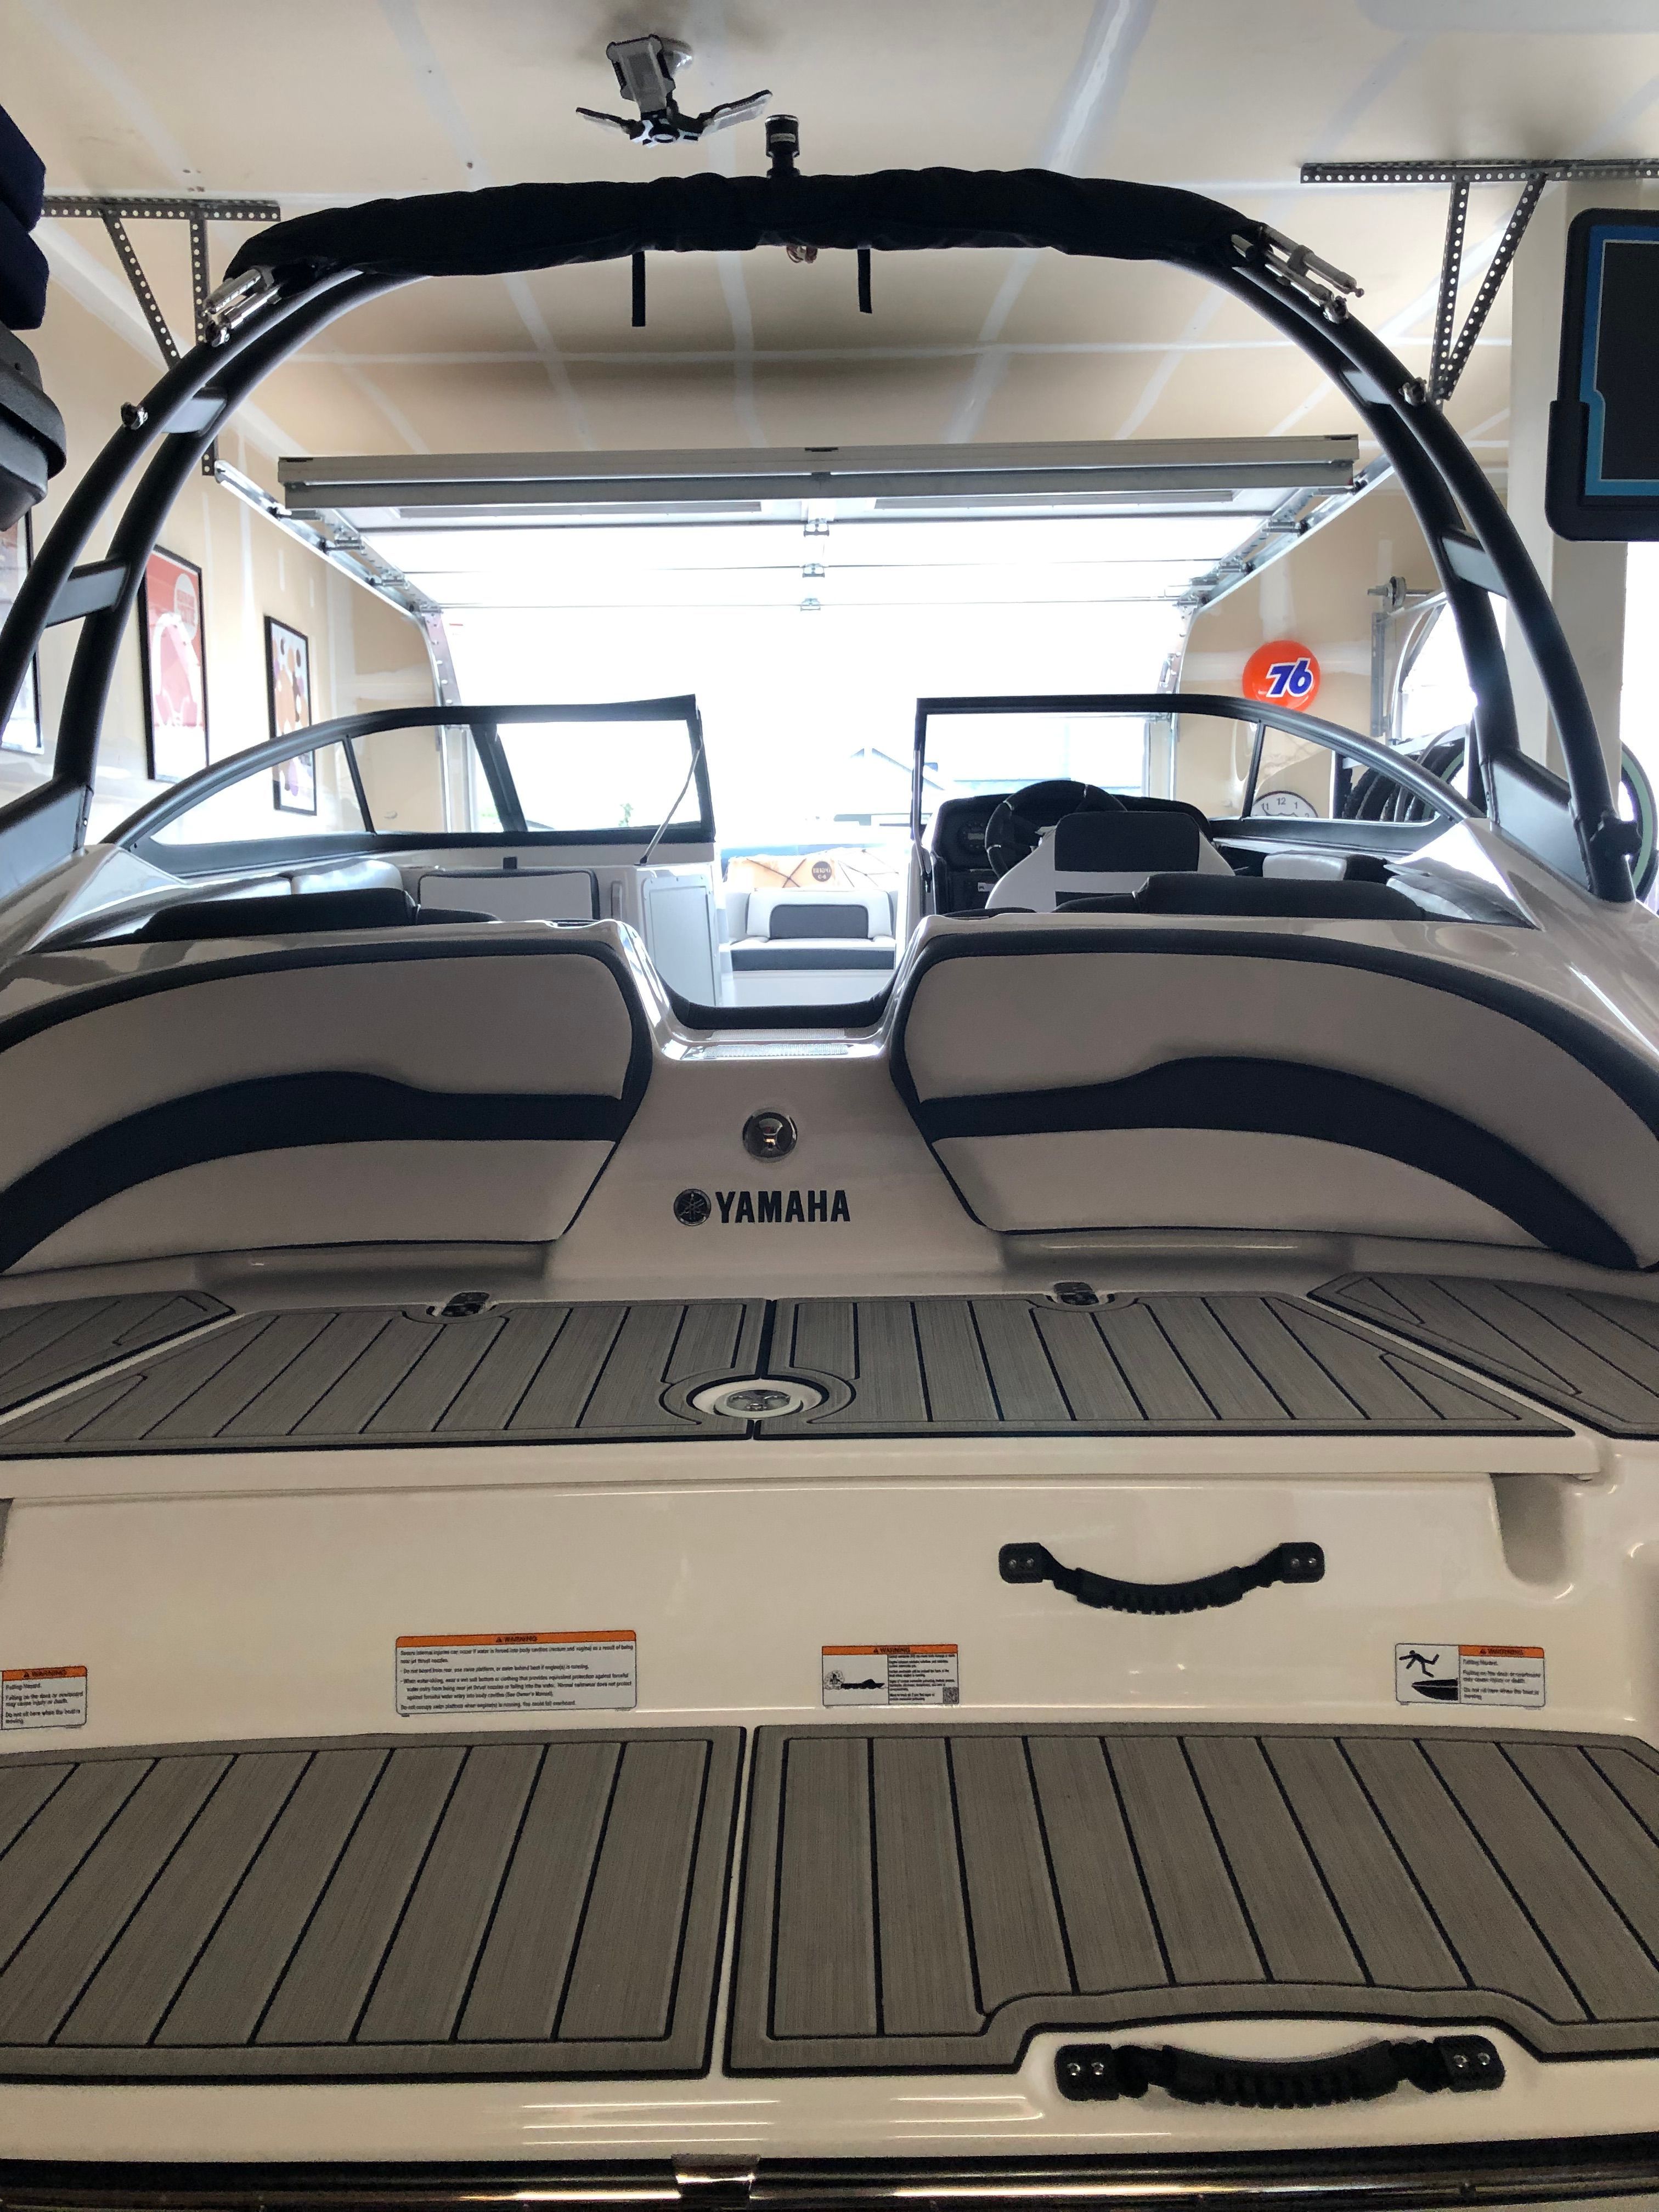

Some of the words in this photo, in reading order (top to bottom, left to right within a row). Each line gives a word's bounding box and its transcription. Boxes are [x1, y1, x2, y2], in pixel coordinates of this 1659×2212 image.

[1266, 657, 1314, 697] 76
[1277, 797, 1286, 805] 12
[715, 1190, 850, 1223] YAMAHA
